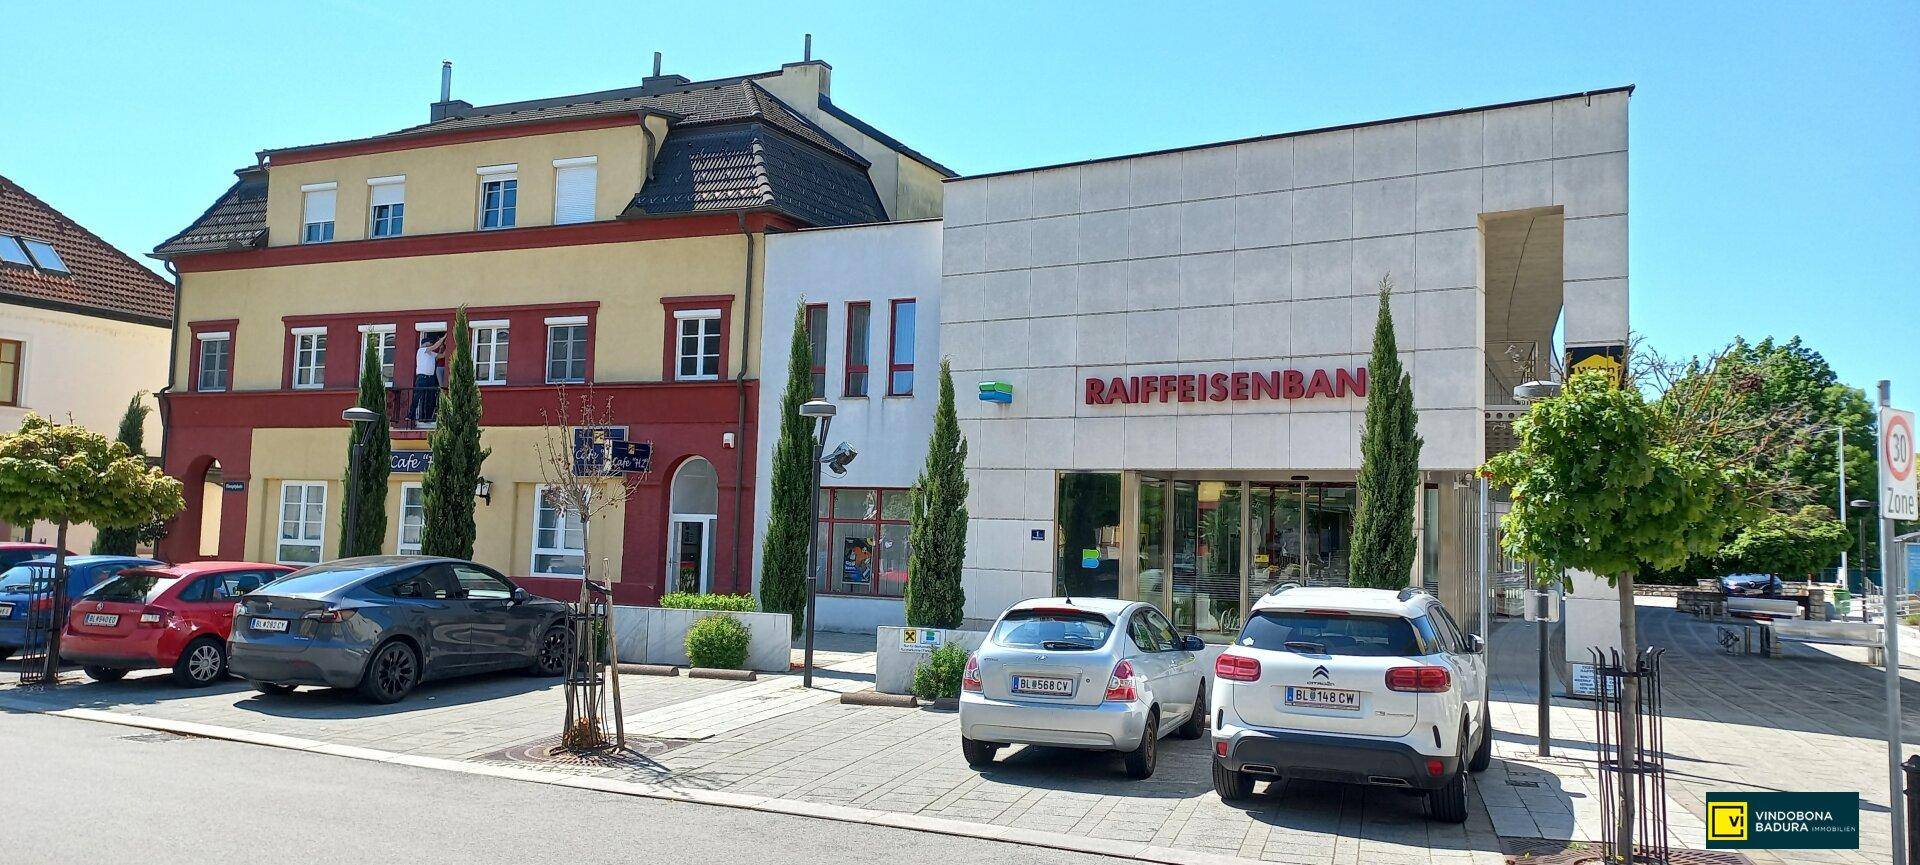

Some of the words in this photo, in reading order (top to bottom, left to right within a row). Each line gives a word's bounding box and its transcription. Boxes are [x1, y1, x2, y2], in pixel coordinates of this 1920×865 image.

[1085, 367, 1367, 405] RAIFFEISENBAN
[1893, 433, 1907, 463] 30
[390, 453, 420, 471] Cafe
[612, 457, 632, 468] Cafe
[1887, 486, 1914, 515] Zone
[1020, 679, 1030, 688] BL
[1037, 680, 1055, 690] 568
[1296, 689, 1310, 701] BL
[1318, 691, 1336, 702] 148
[1339, 693, 1354, 704] CW
